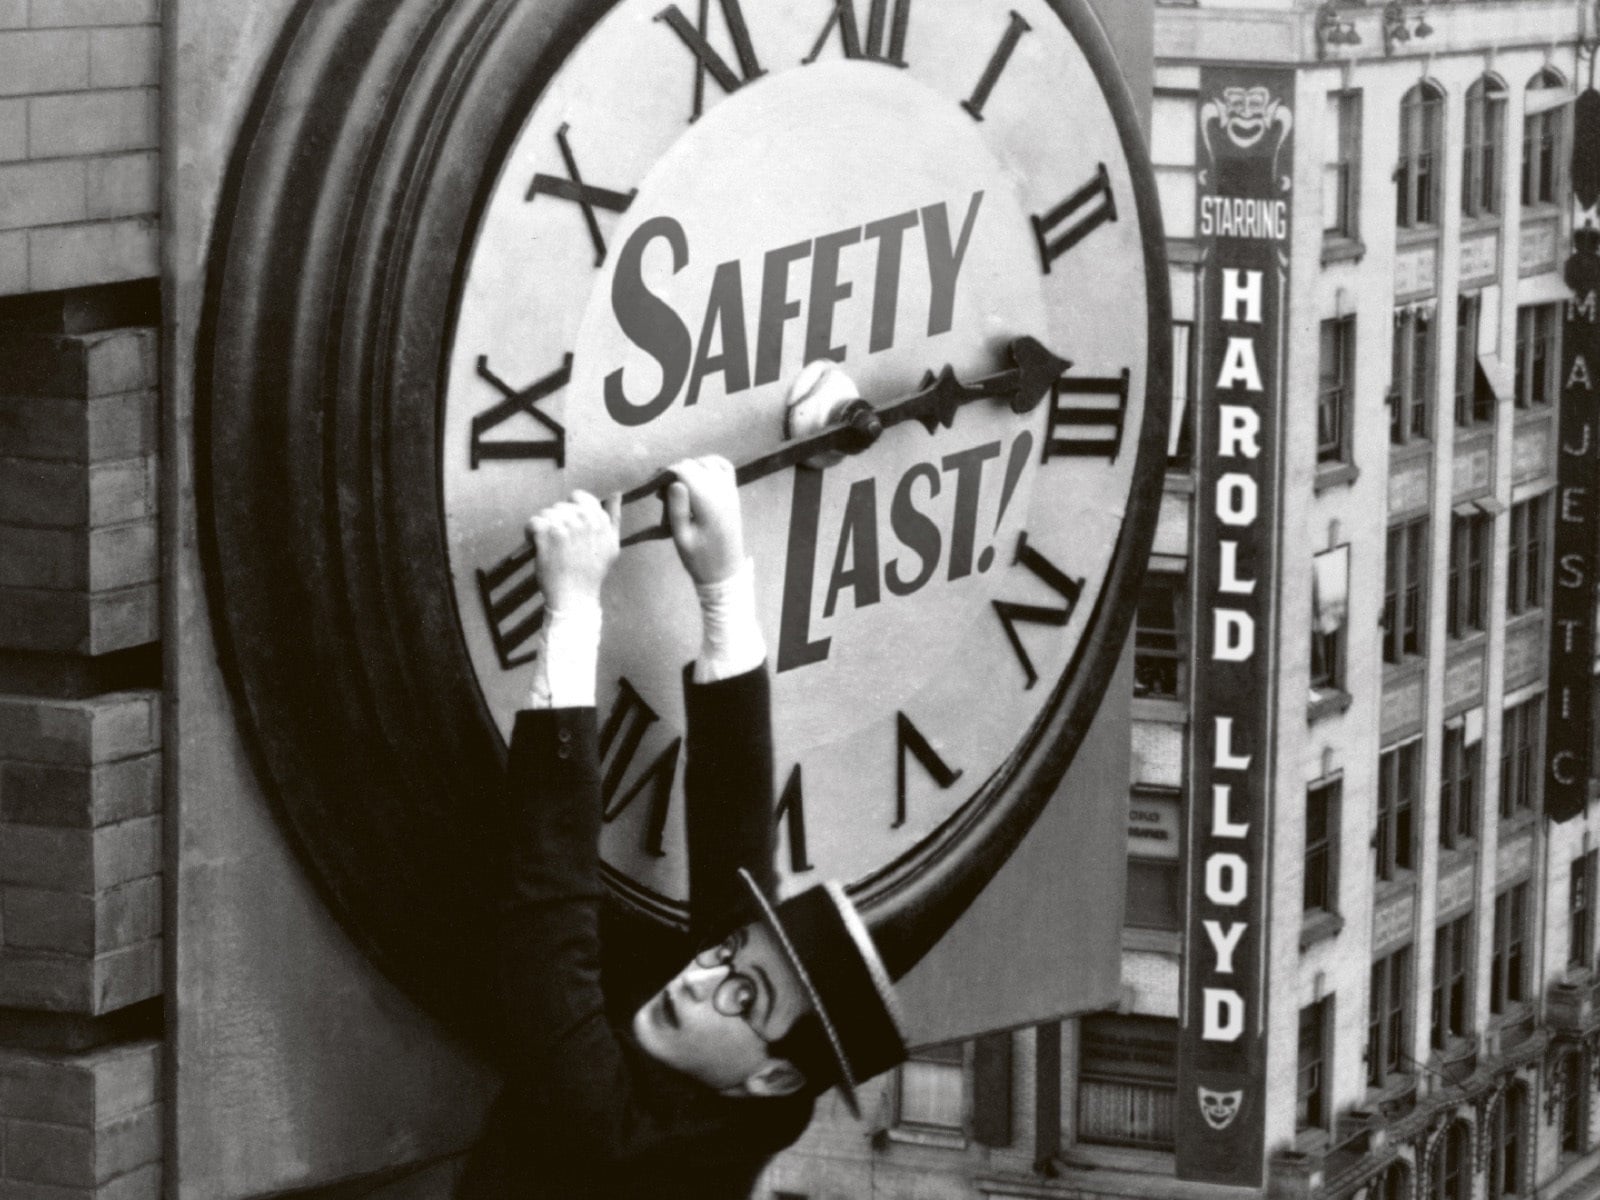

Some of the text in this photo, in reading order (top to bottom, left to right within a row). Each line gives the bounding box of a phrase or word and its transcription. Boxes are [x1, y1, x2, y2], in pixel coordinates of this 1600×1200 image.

[525, 122, 639, 268] X
[1030, 162, 1118, 275] II
[1200, 195, 1287, 240] STARRING
[603, 190, 985, 427] SAFETY
[775, 430, 1034, 674] LAST!
[1552, 290, 1597, 785] MAJESTIC
[1202, 268, 1263, 1041] HAROLD LLOYD
[891, 710, 963, 829] V
